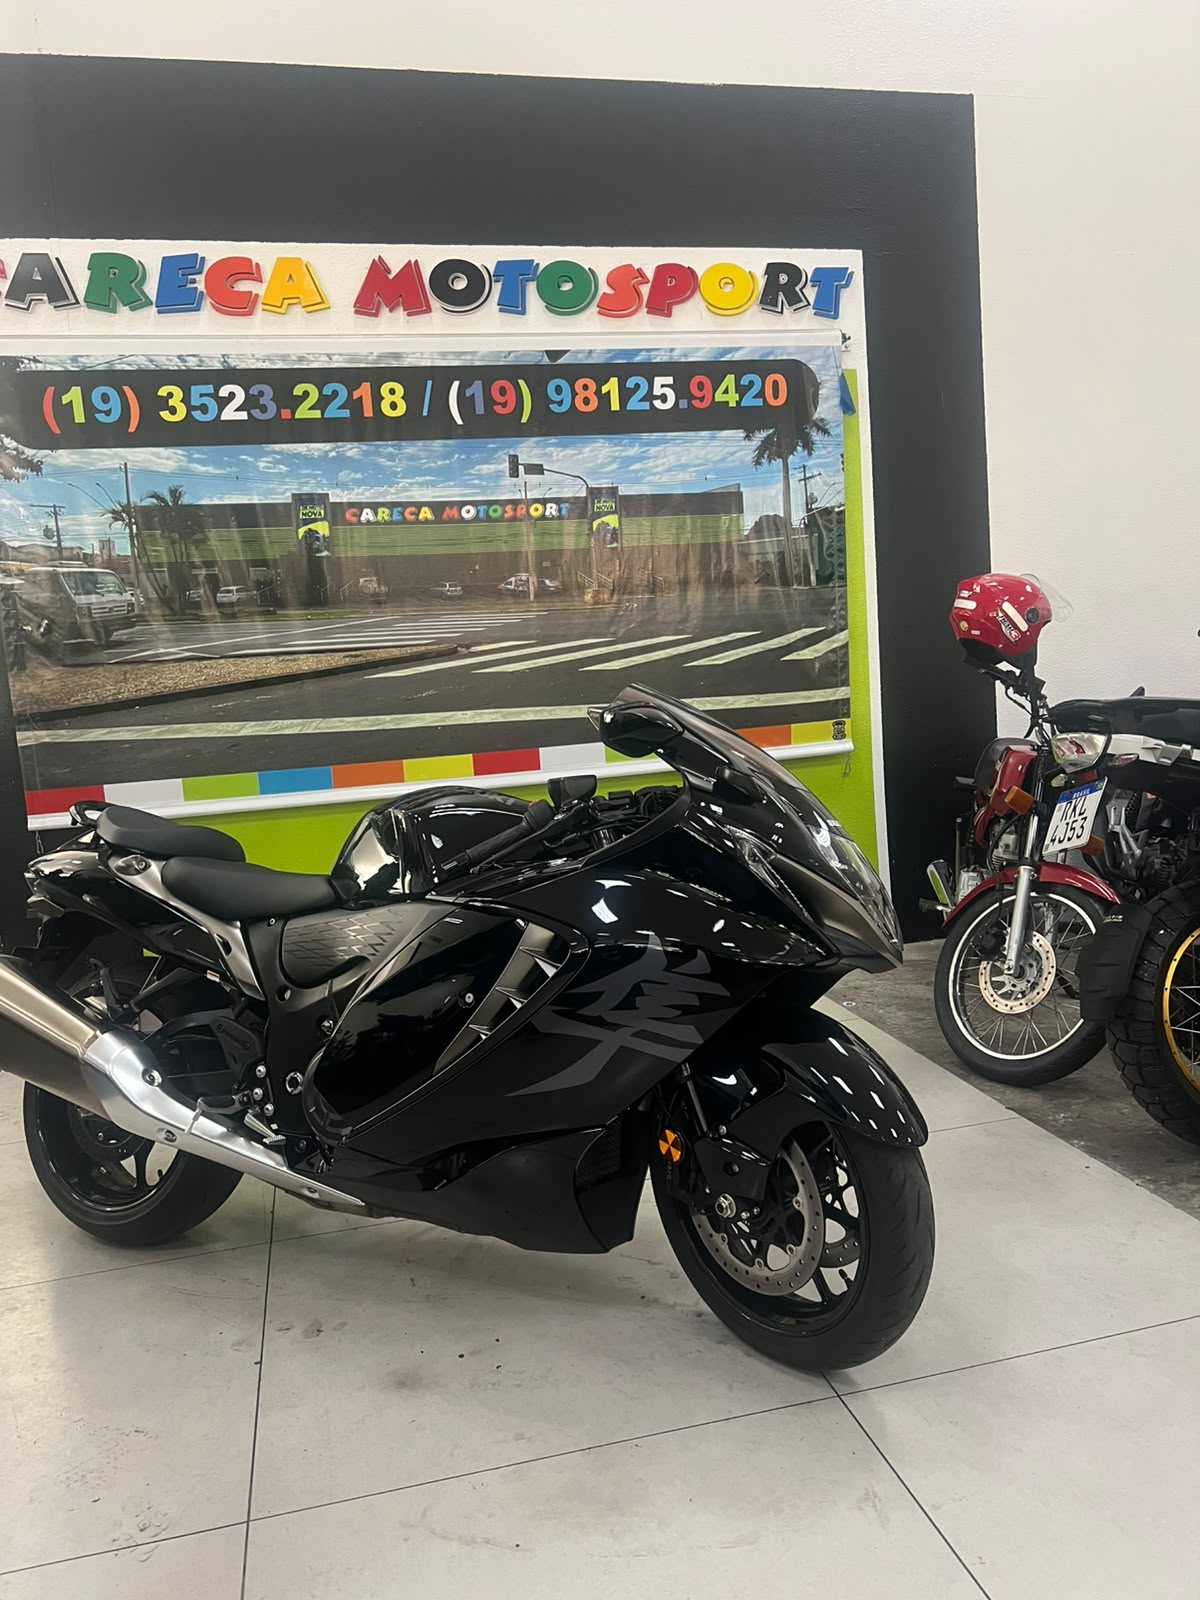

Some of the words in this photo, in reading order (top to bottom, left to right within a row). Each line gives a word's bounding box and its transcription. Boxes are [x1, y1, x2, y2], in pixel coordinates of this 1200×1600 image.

[0, 252, 330, 316] ARECA
[354, 254, 854, 320] MOTOSPORT
[43, 385, 140, 434] (19)
[157, 381, 407, 423] 3523.2218
[422, 380, 433, 417] /
[448, 379, 532, 425] (19)
[547, 373, 788, 415] 98125.9420
[345, 506, 435, 523] CARECA
[442, 502, 569, 520] MOTOSPORT
[1050, 816, 1088, 846] 4J53
